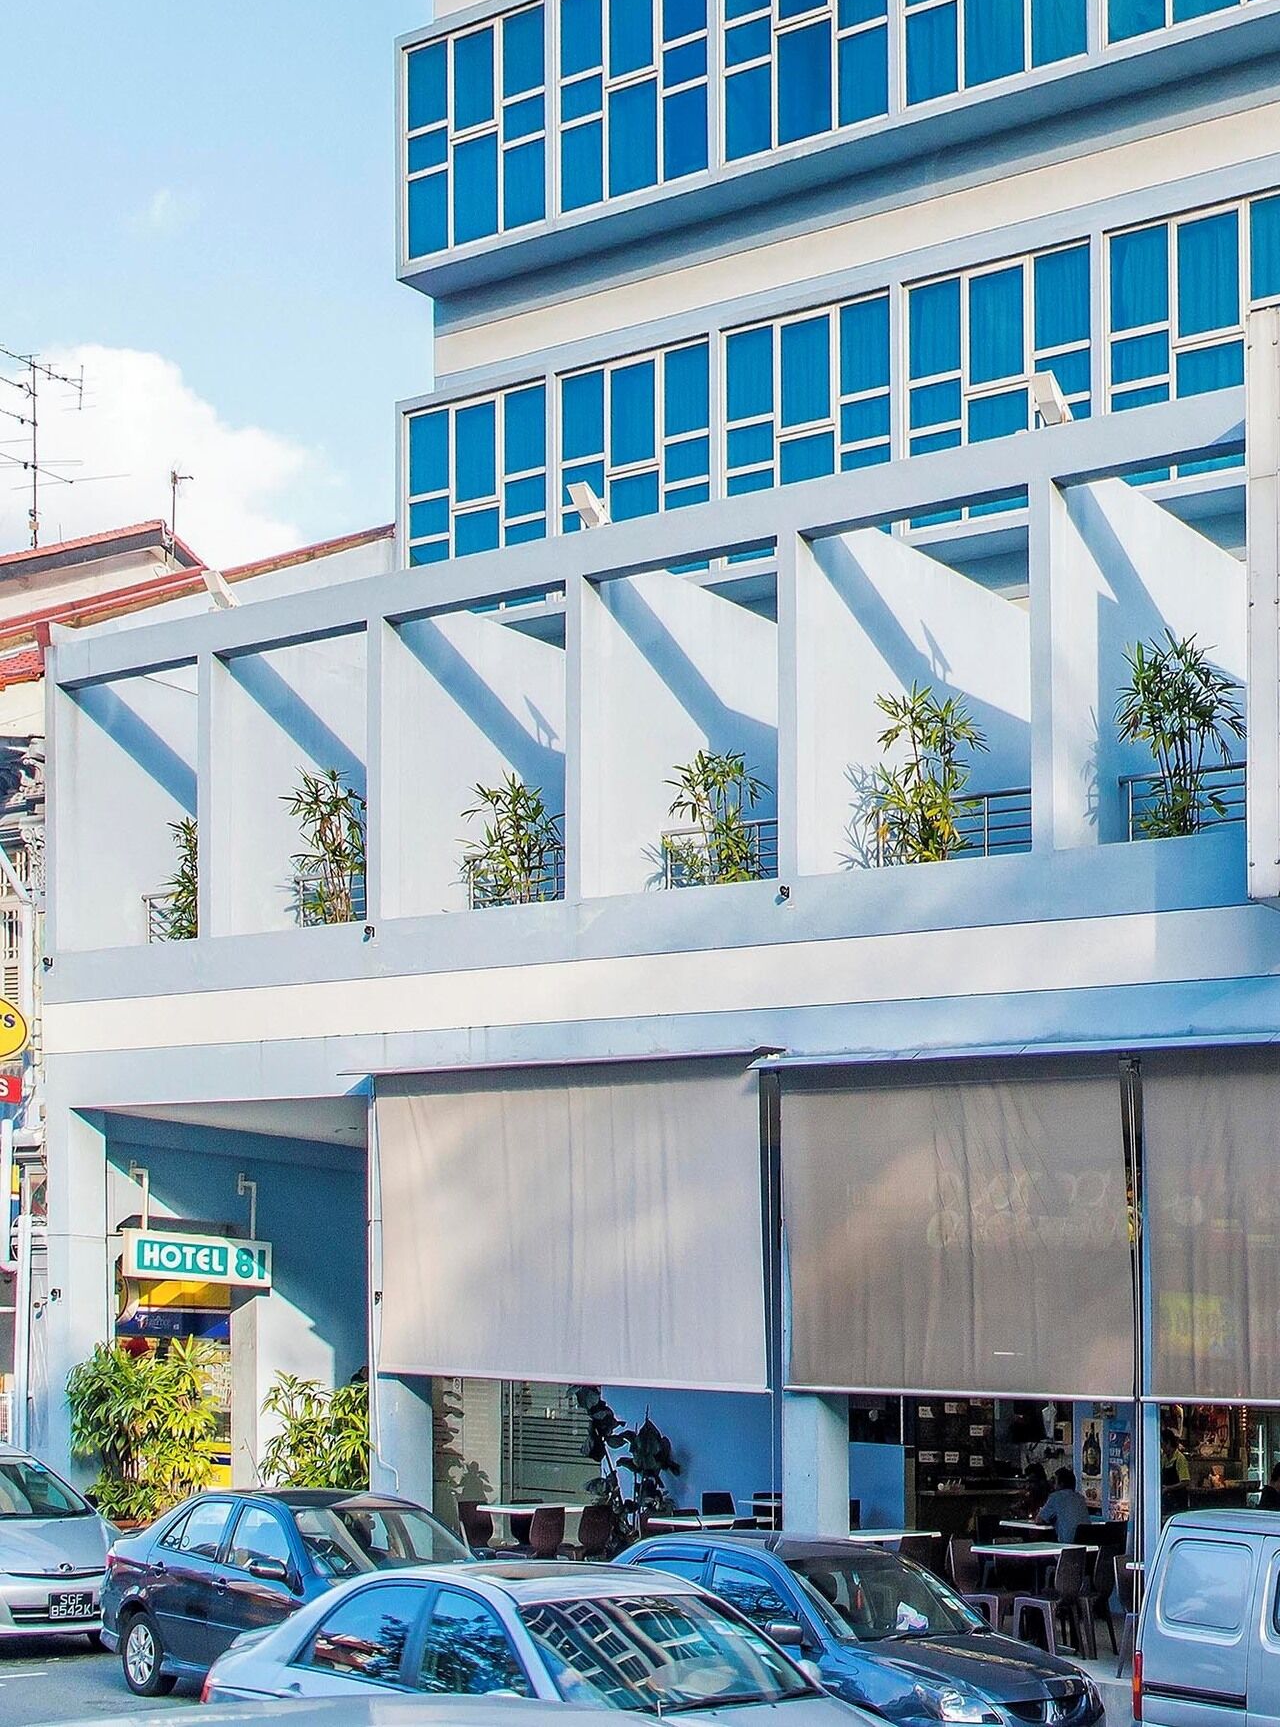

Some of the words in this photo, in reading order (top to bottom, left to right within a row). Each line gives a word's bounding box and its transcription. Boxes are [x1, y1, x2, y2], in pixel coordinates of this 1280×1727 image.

[143, 1242, 225, 1272] HOTEL
[235, 1247, 266, 1280] 81
[60, 1593, 84, 1605] SGF
[51, 1603, 92, 1617] 8542K
